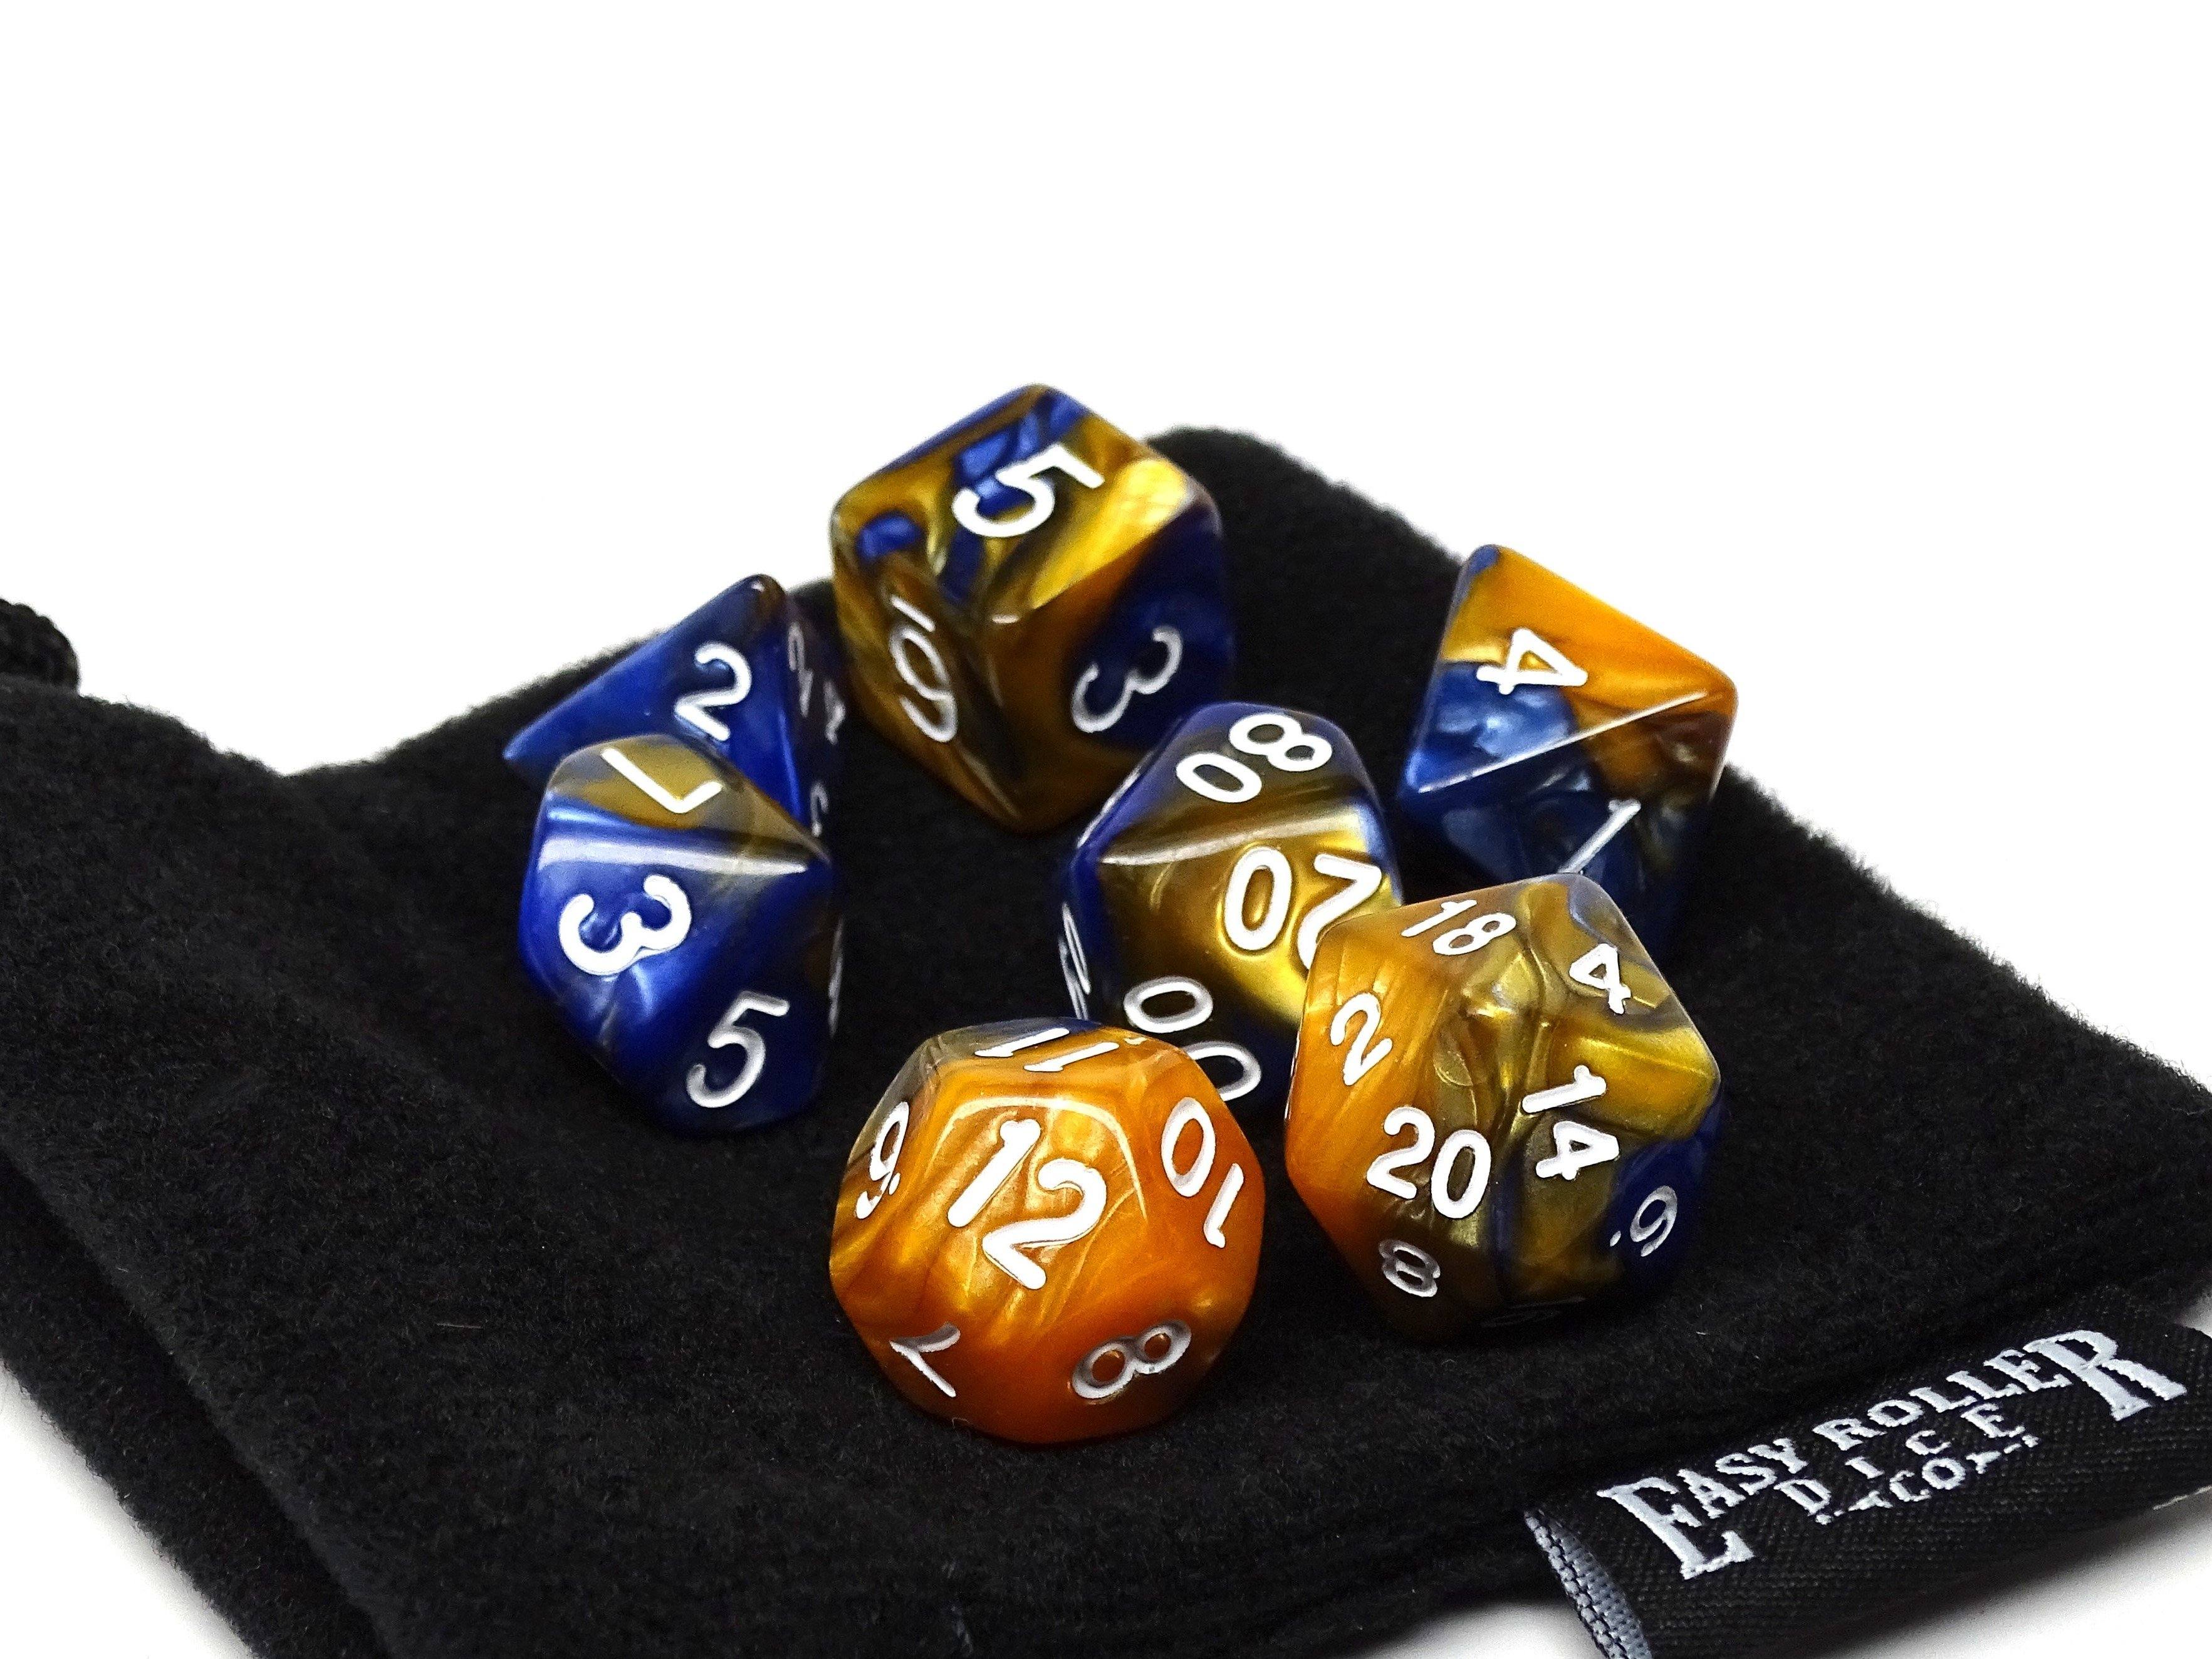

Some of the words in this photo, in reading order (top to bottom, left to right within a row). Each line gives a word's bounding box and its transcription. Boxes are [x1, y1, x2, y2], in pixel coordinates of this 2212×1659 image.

[952, 443, 1105, 538] 5
[673, 642, 753, 742] 2
[1072, 626, 1183, 734] 3
[1475, 627, 1589, 696] 4
[1175, 712, 1333, 803] 80
[1556, 798, 1642, 874] 1
[558, 874, 692, 976] 3
[1401, 899, 1517, 956] 18
[1568, 943, 1632, 1016] 4
[686, 991, 791, 1109] 5
[1329, 992, 1394, 1087] 2
[1161, 1096, 1244, 1249] 10
[1365, 1106, 1493, 1220] 20
[1521, 1064, 1621, 1181] 14
[947, 1118, 1108, 1290] 12
[1378, 1238, 1441, 1299] 8
[1071, 1320, 1192, 1400] 8
[1595, 1436, 1810, 1581] EASY
[1811, 1329, 2188, 1452] ROLLER
[1772, 1402, 2027, 1517] DICE
